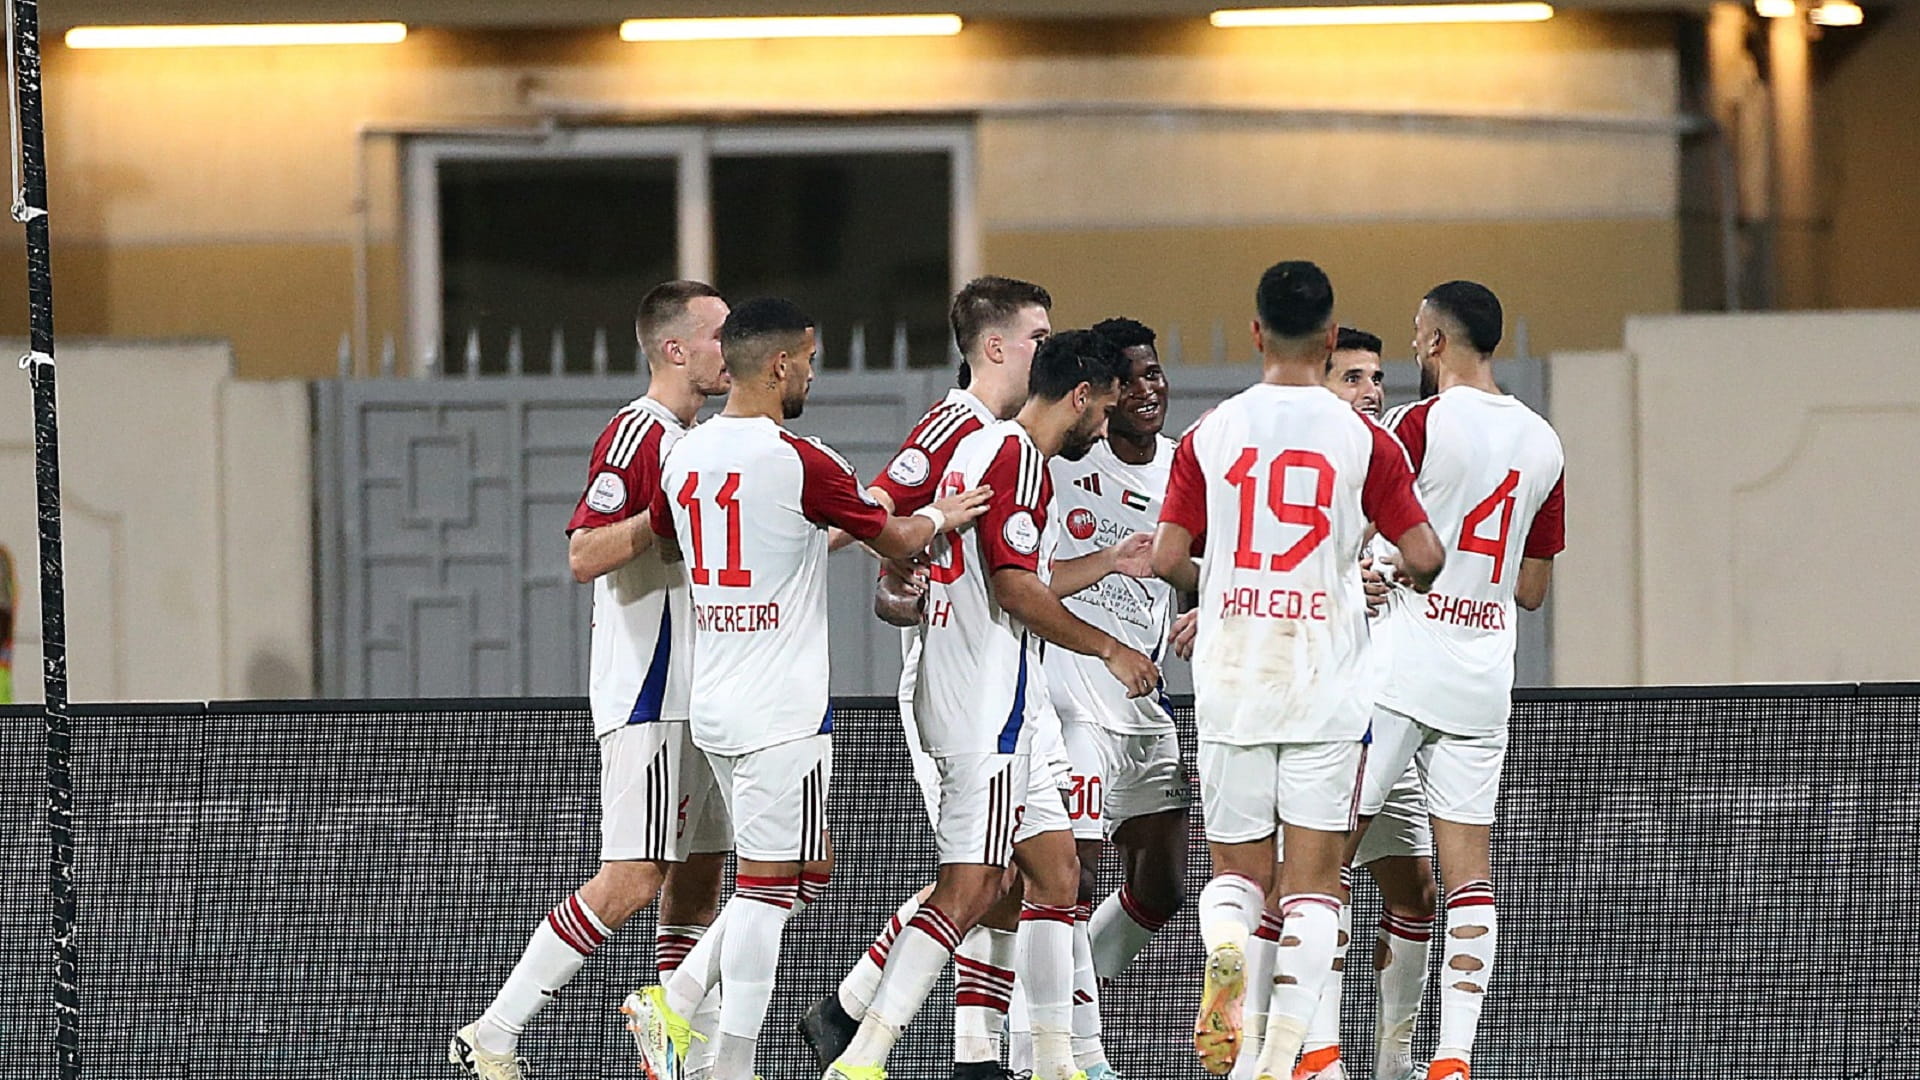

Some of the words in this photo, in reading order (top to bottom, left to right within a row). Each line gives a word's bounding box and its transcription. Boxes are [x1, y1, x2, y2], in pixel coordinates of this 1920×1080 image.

[676, 471, 752, 588] 11
[1224, 446, 1337, 573] 19
[1457, 469, 1521, 585] 4
[1067, 775, 1103, 820] 30
